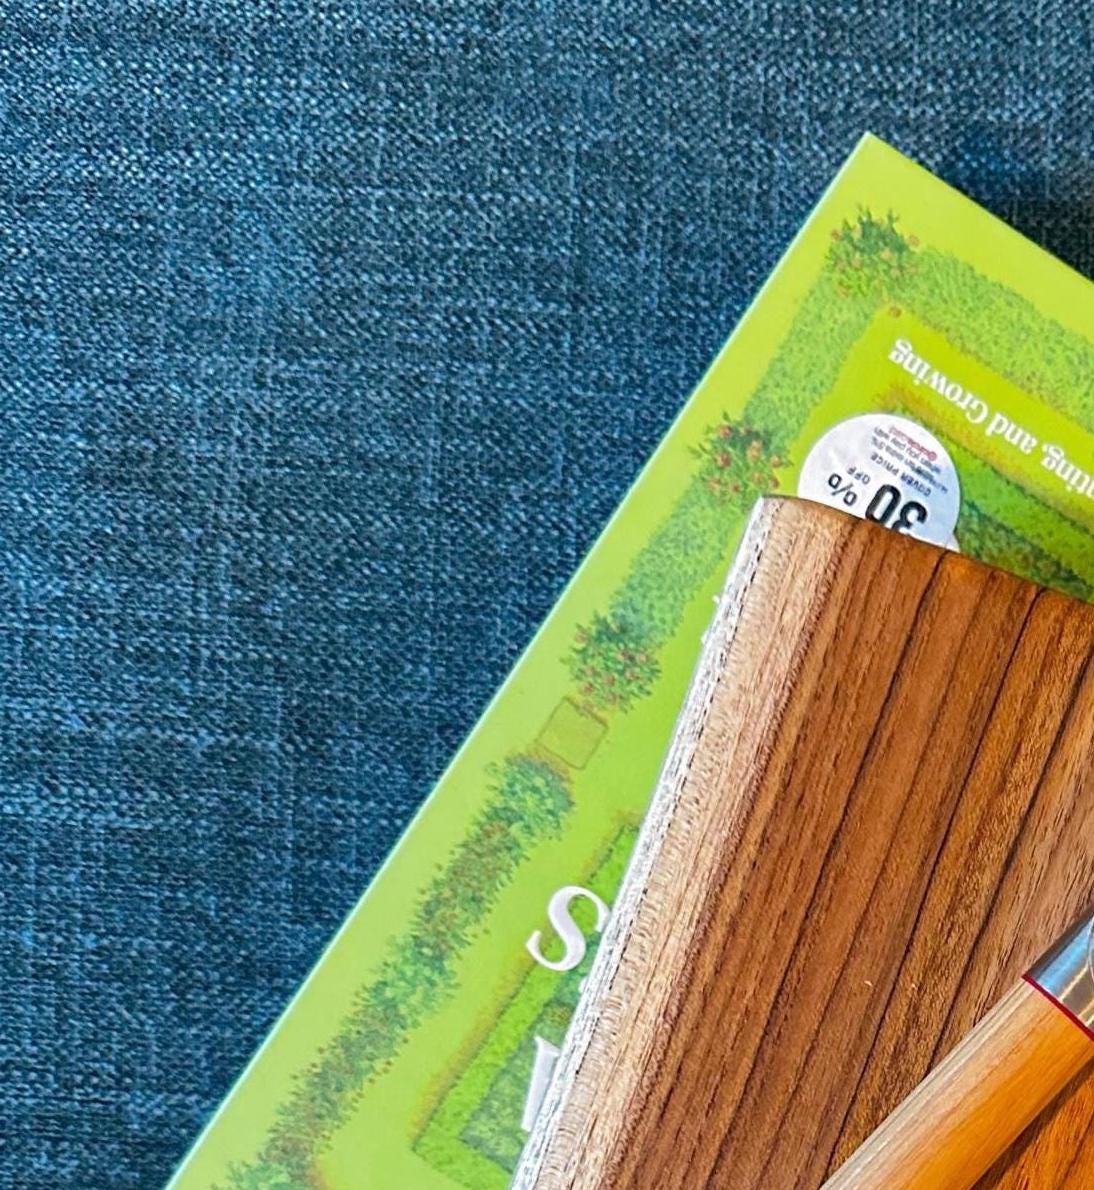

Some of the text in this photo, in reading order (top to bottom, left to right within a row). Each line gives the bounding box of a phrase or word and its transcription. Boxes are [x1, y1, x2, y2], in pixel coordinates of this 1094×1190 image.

[888, 338, 989, 425] Growing
[984, 413, 1038, 456] and
[847, 465, 872, 486] OFF
[870, 452, 900, 476] PRICE
[900, 472, 932, 497] COVER
